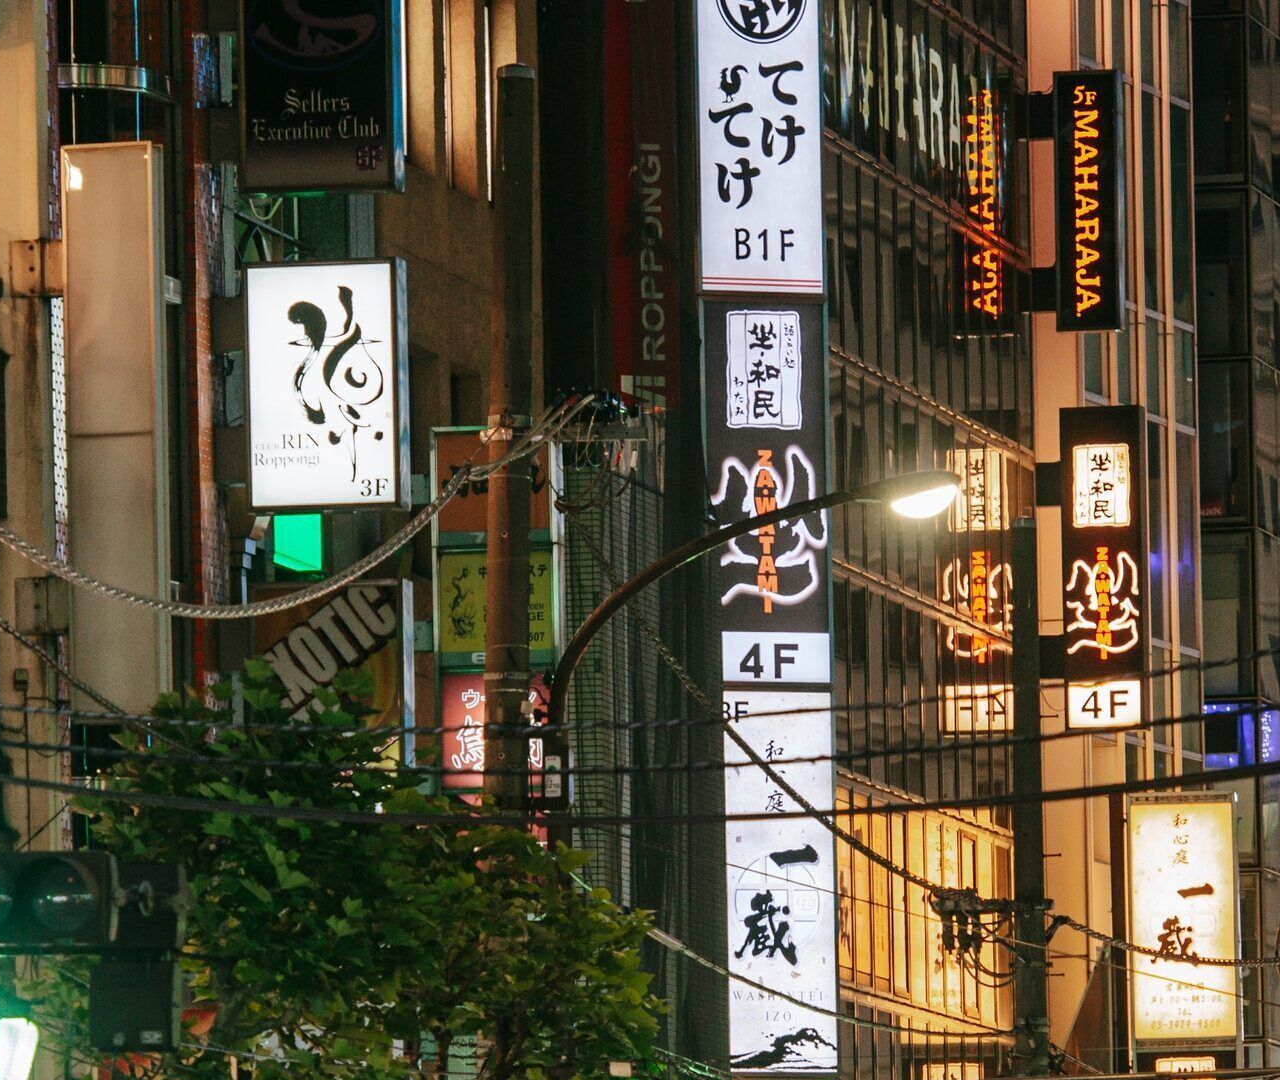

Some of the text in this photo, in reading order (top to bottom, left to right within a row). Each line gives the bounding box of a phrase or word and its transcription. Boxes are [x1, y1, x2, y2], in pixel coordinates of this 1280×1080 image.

[281, 88, 350, 120] Sellers
[1073, 85, 1097, 105] 5F
[758, 60, 806, 165] てけ
[252, 115, 380, 142] Executive Club
[708, 102, 761, 209] てけ
[640, 142, 666, 362] ROPPONGI
[735, 228, 795, 261] B1F
[282, 433, 320, 449] RIN
[254, 453, 320, 469] Roppongi
[360, 479, 388, 497] 3F
[478, 565, 548, 579] 中ステ
[265, 586, 397, 706] XOTIC
[739, 643, 799, 679] 4F
[1081, 690, 1129, 719] 4F
[766, 1011, 793, 1022] IZO
